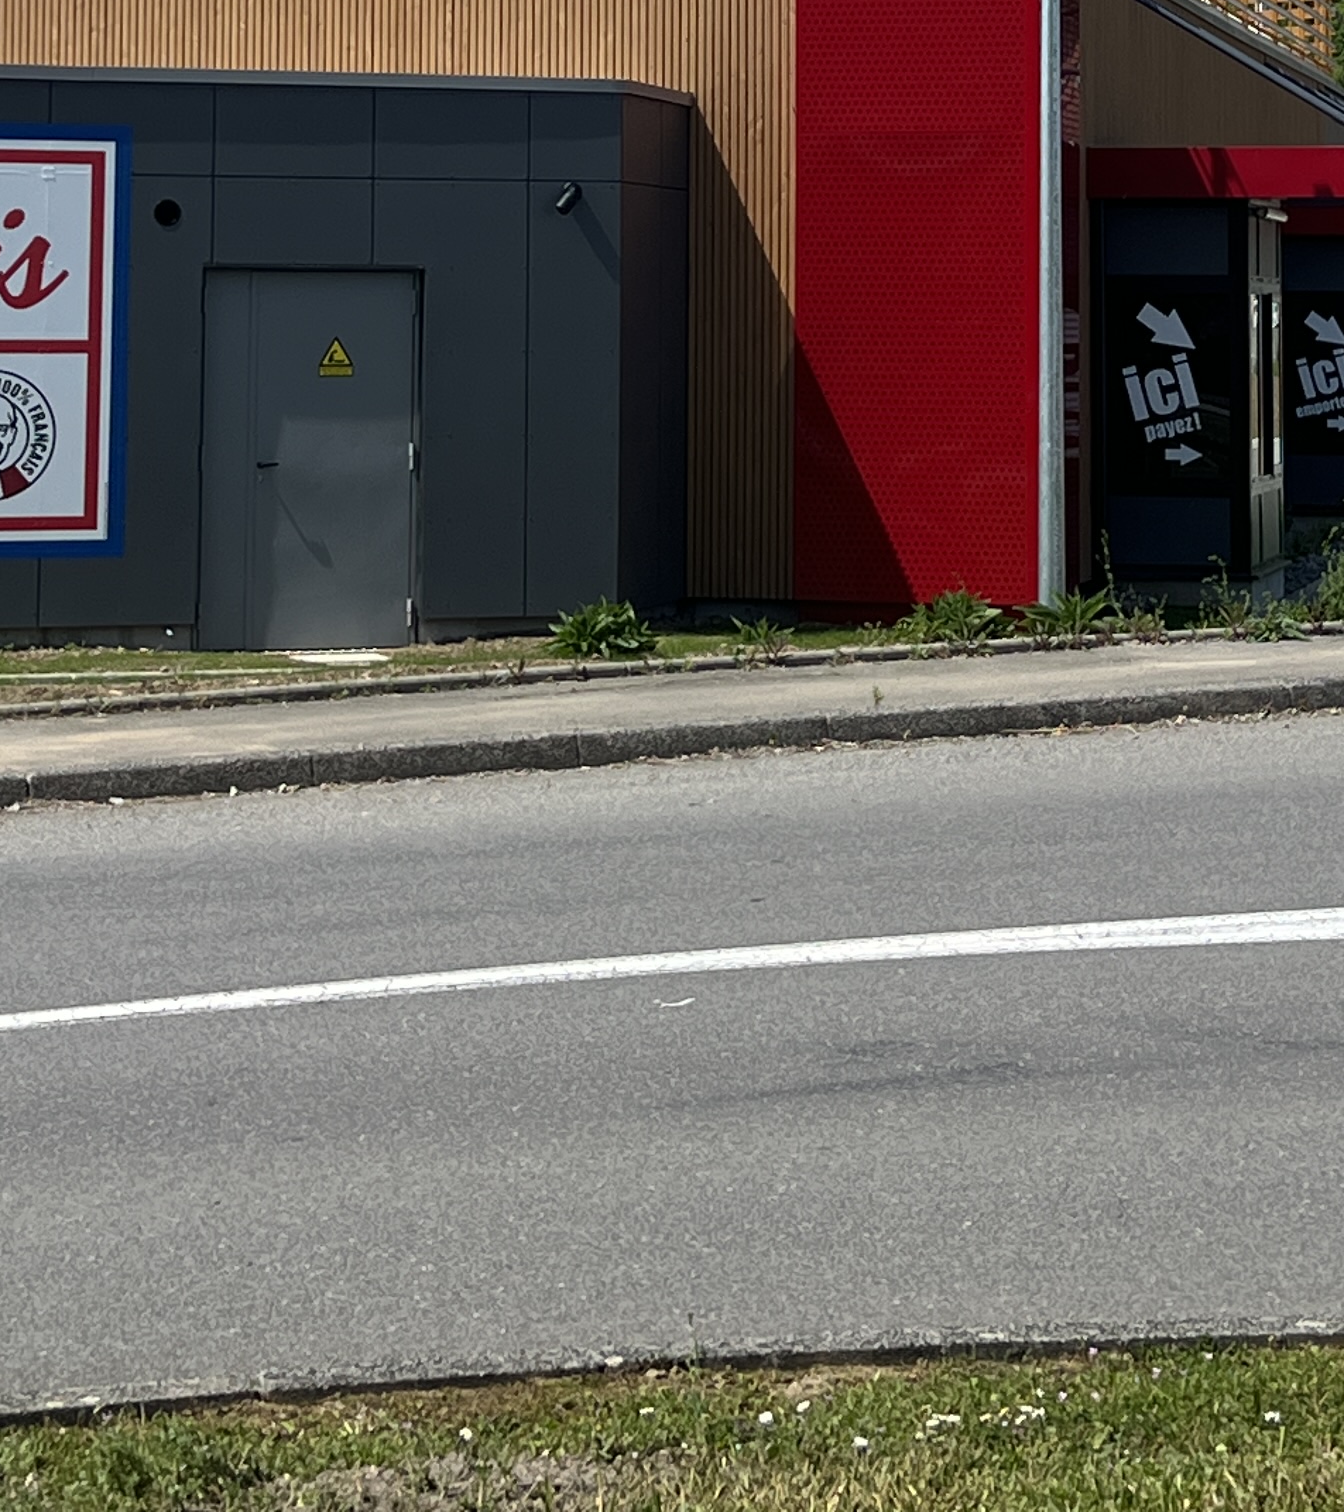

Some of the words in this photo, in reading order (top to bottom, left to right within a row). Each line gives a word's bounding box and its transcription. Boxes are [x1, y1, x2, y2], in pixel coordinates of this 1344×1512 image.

[1122, 352, 1200, 421] ici
[21, 403, 49, 476] FRANÇAIS
[1144, 412, 1202, 443] payez!
